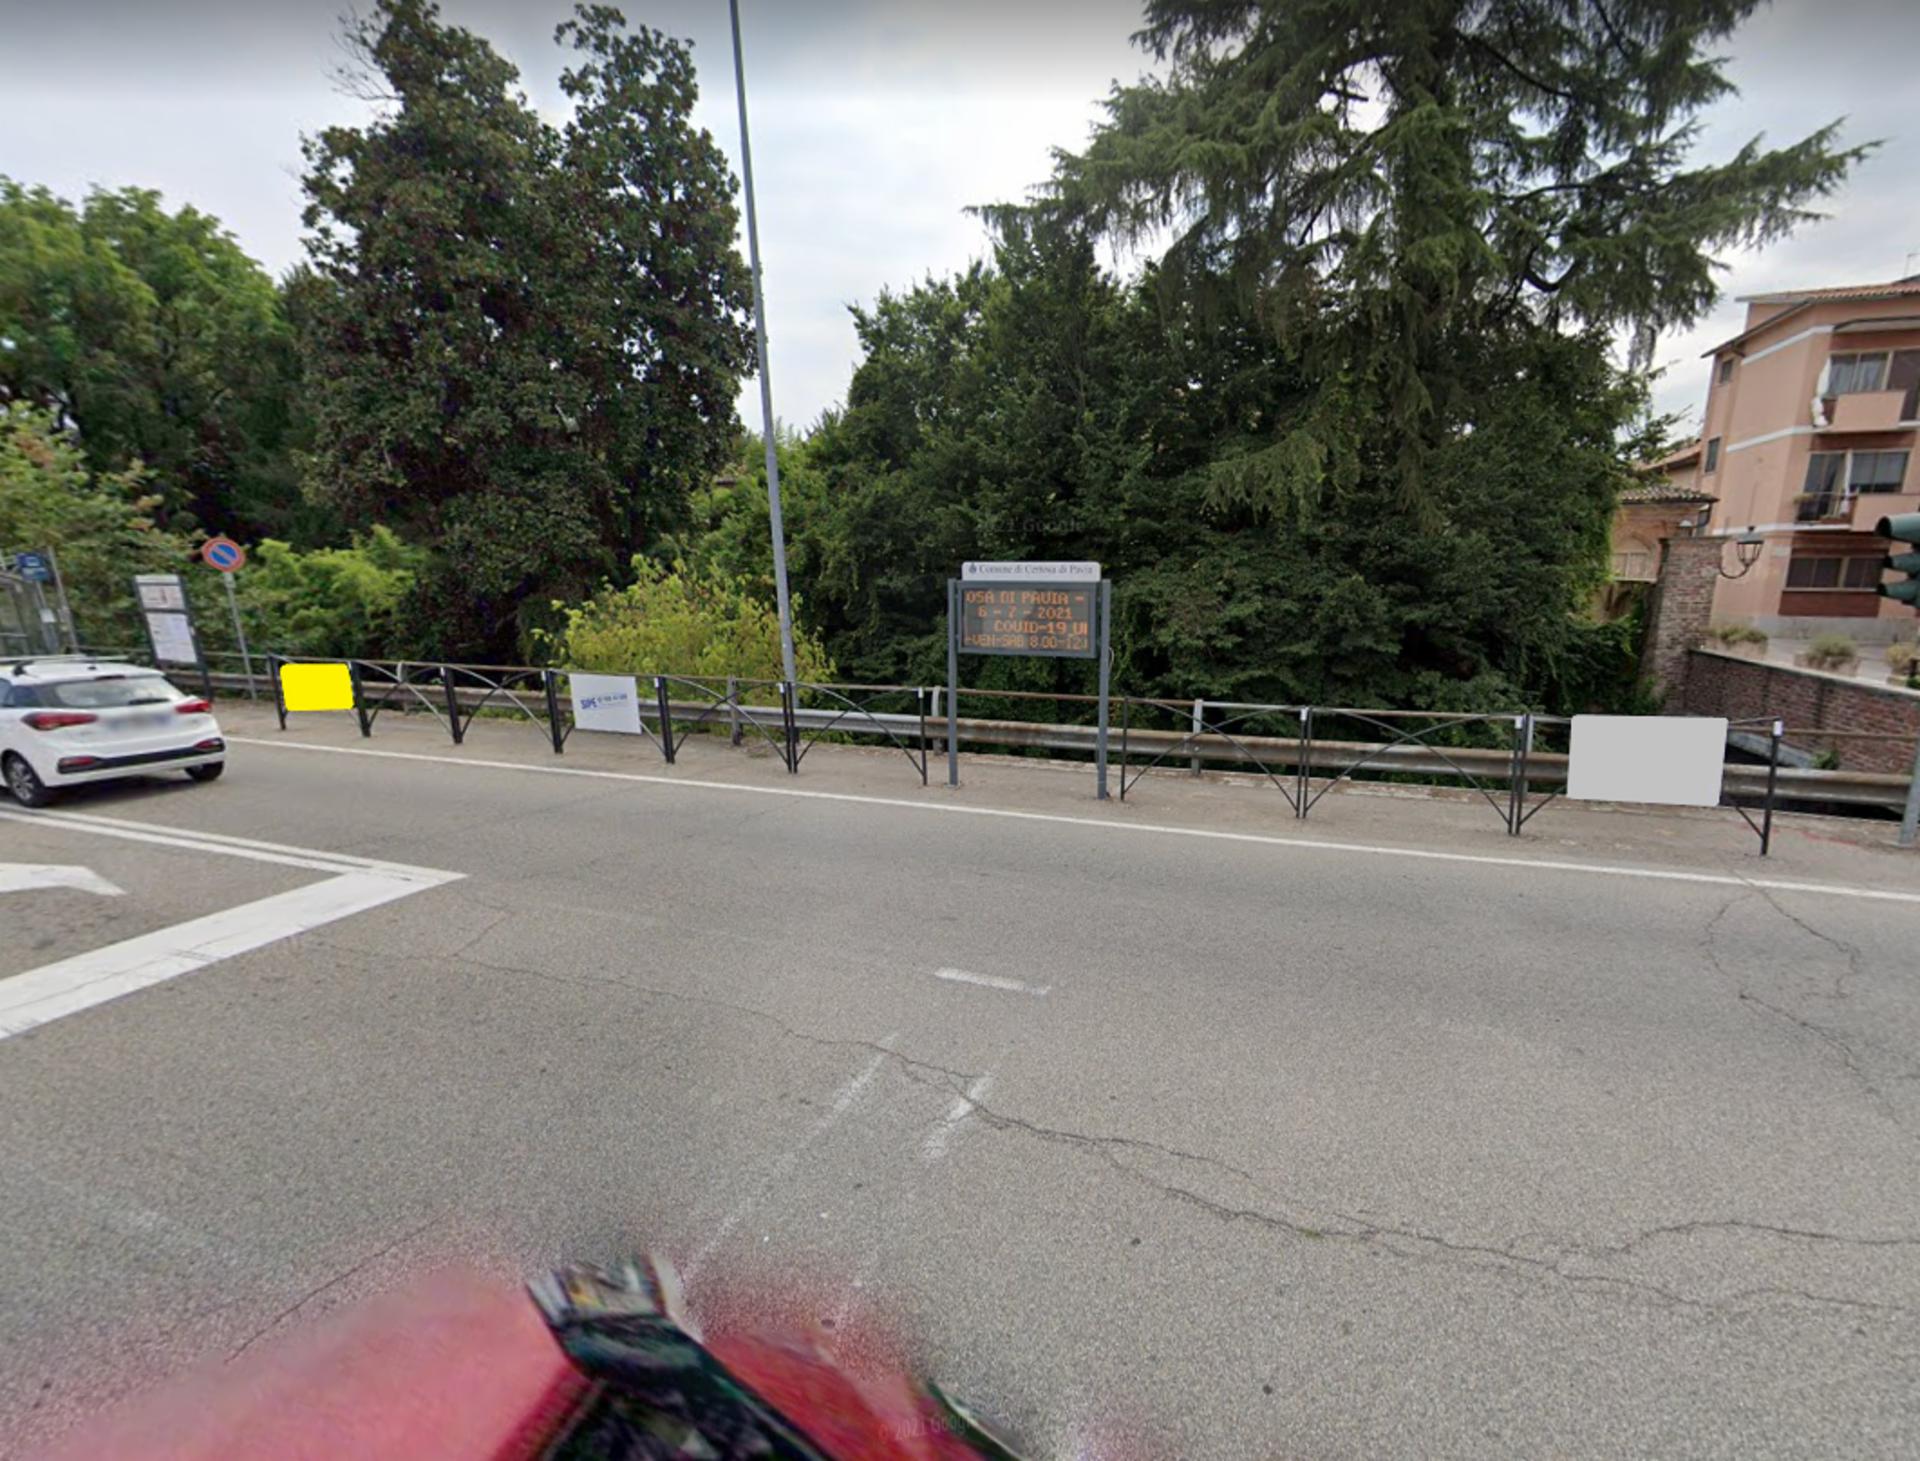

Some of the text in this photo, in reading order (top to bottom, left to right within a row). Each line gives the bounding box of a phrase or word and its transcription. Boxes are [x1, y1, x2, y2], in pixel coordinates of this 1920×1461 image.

[1070, 564, 1093, 574] Pavia
[965, 590, 994, 604] OSA
[1021, 591, 1069, 605] PAVIA
